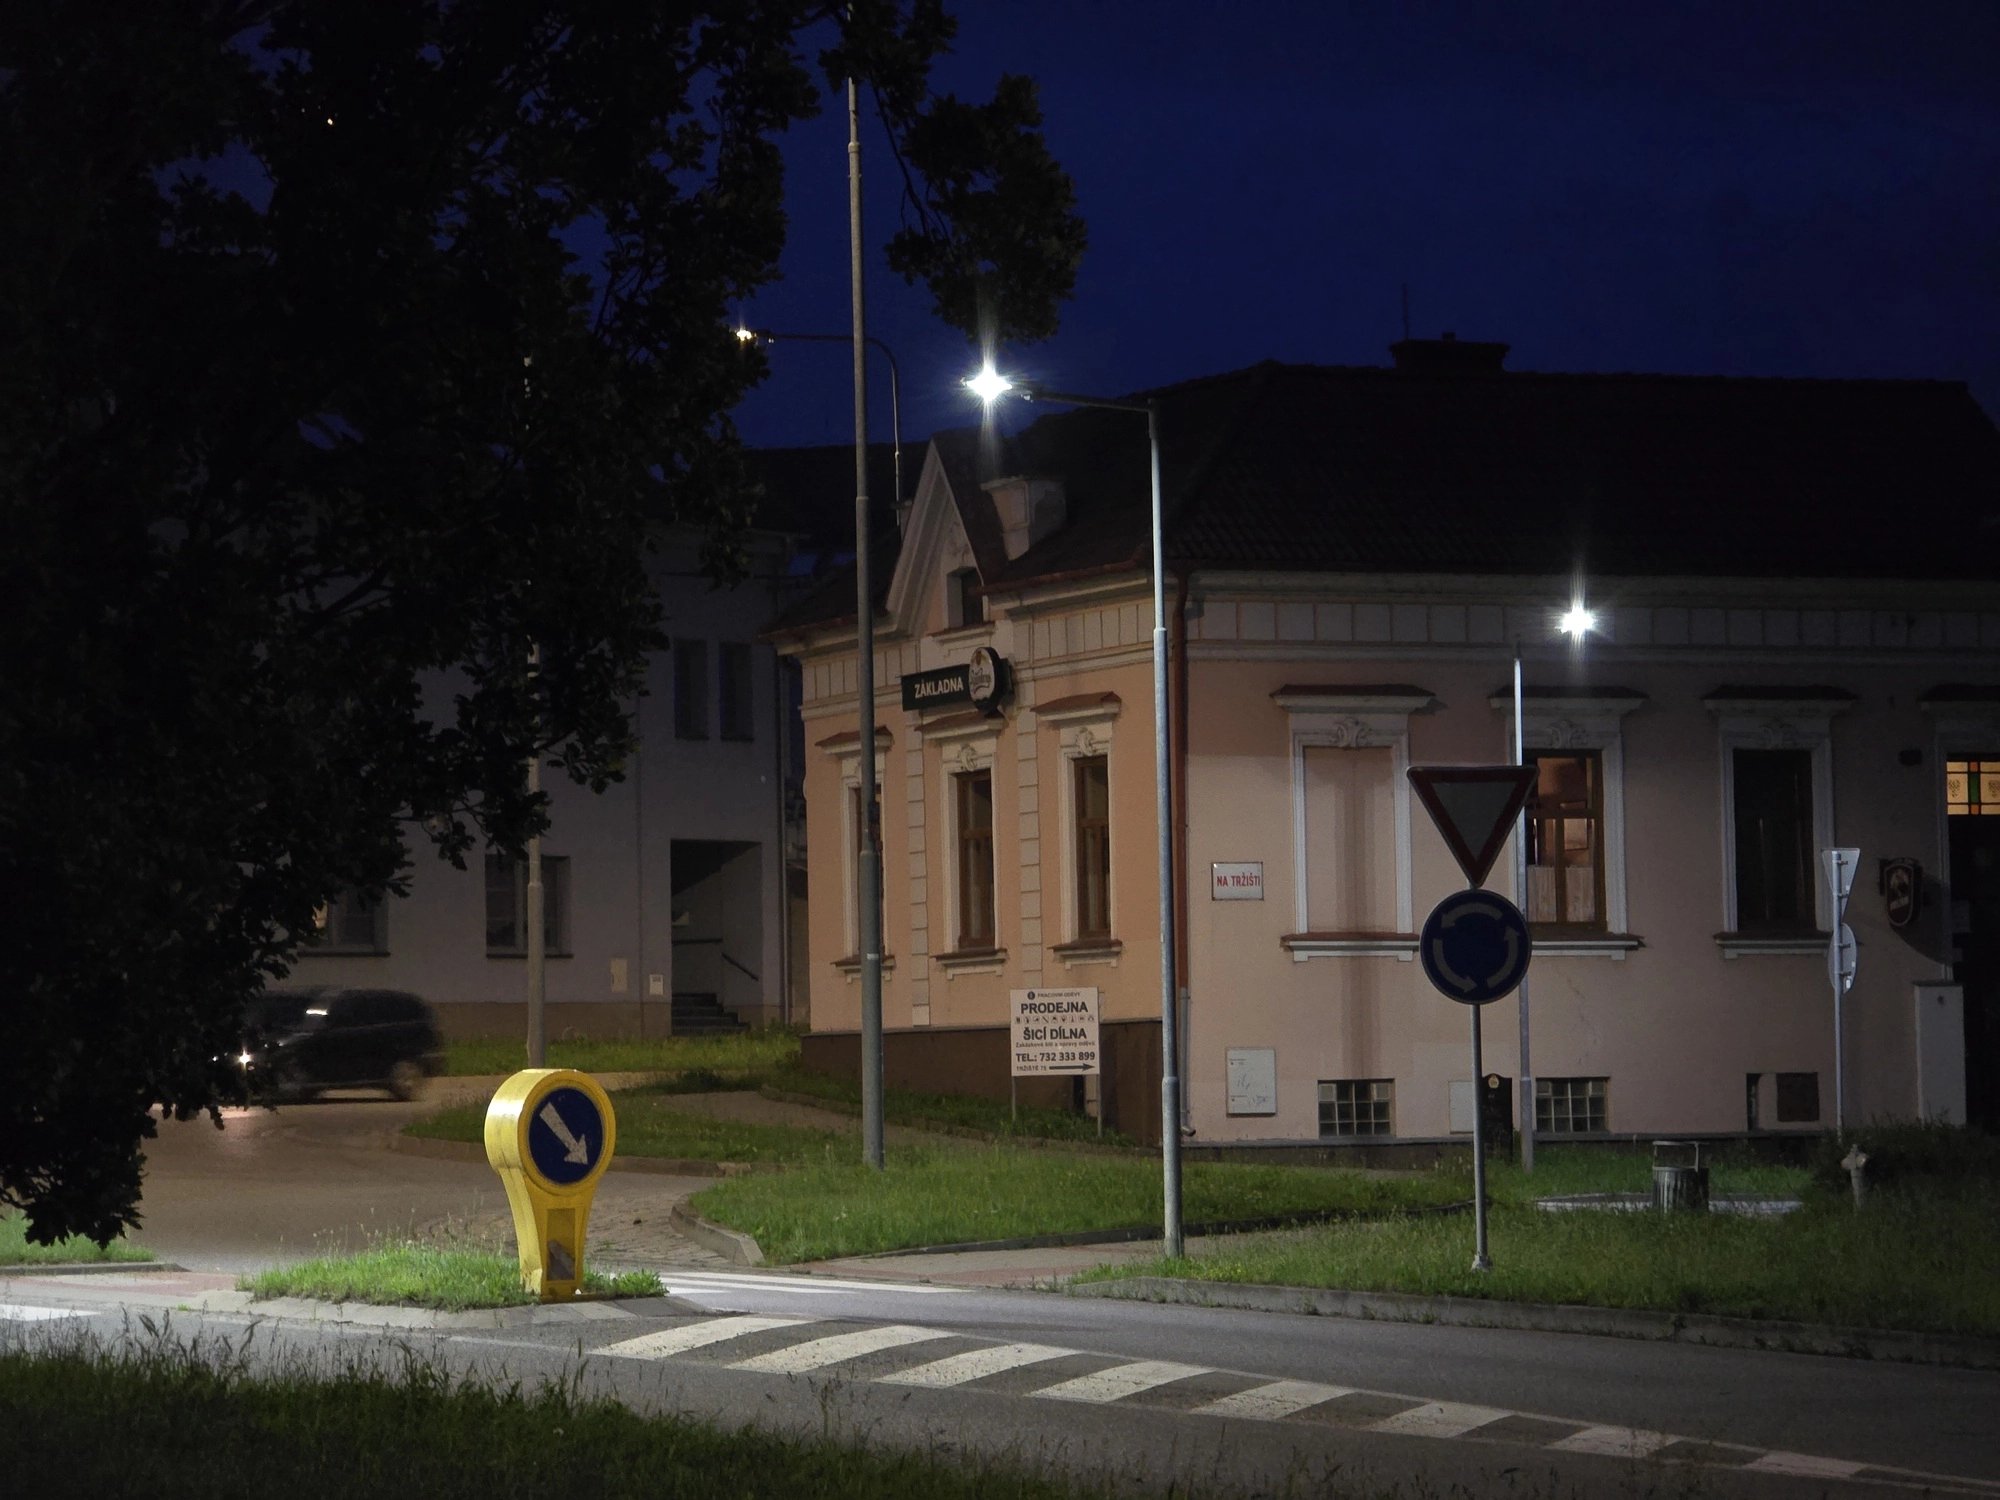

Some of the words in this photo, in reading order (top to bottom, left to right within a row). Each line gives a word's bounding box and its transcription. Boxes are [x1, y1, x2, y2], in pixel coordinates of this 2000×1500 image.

[914, 676, 964, 699] ZÁKLADNA
[1216, 875, 1228, 887] NA
[1231, 872, 1260, 887] TRŽIŠTI
[1020, 1002, 1088, 1014] PRODEJNA
[1023, 1026, 1047, 1041] ŠICÍ
[1050, 1026, 1087, 1040] DÍLNA
[1016, 1053, 1037, 1062] TEL.:
[1039, 1052, 1056, 1062] 732
[1059, 1052, 1076, 1061] 333
[1078, 1051, 1095, 1061] 899
